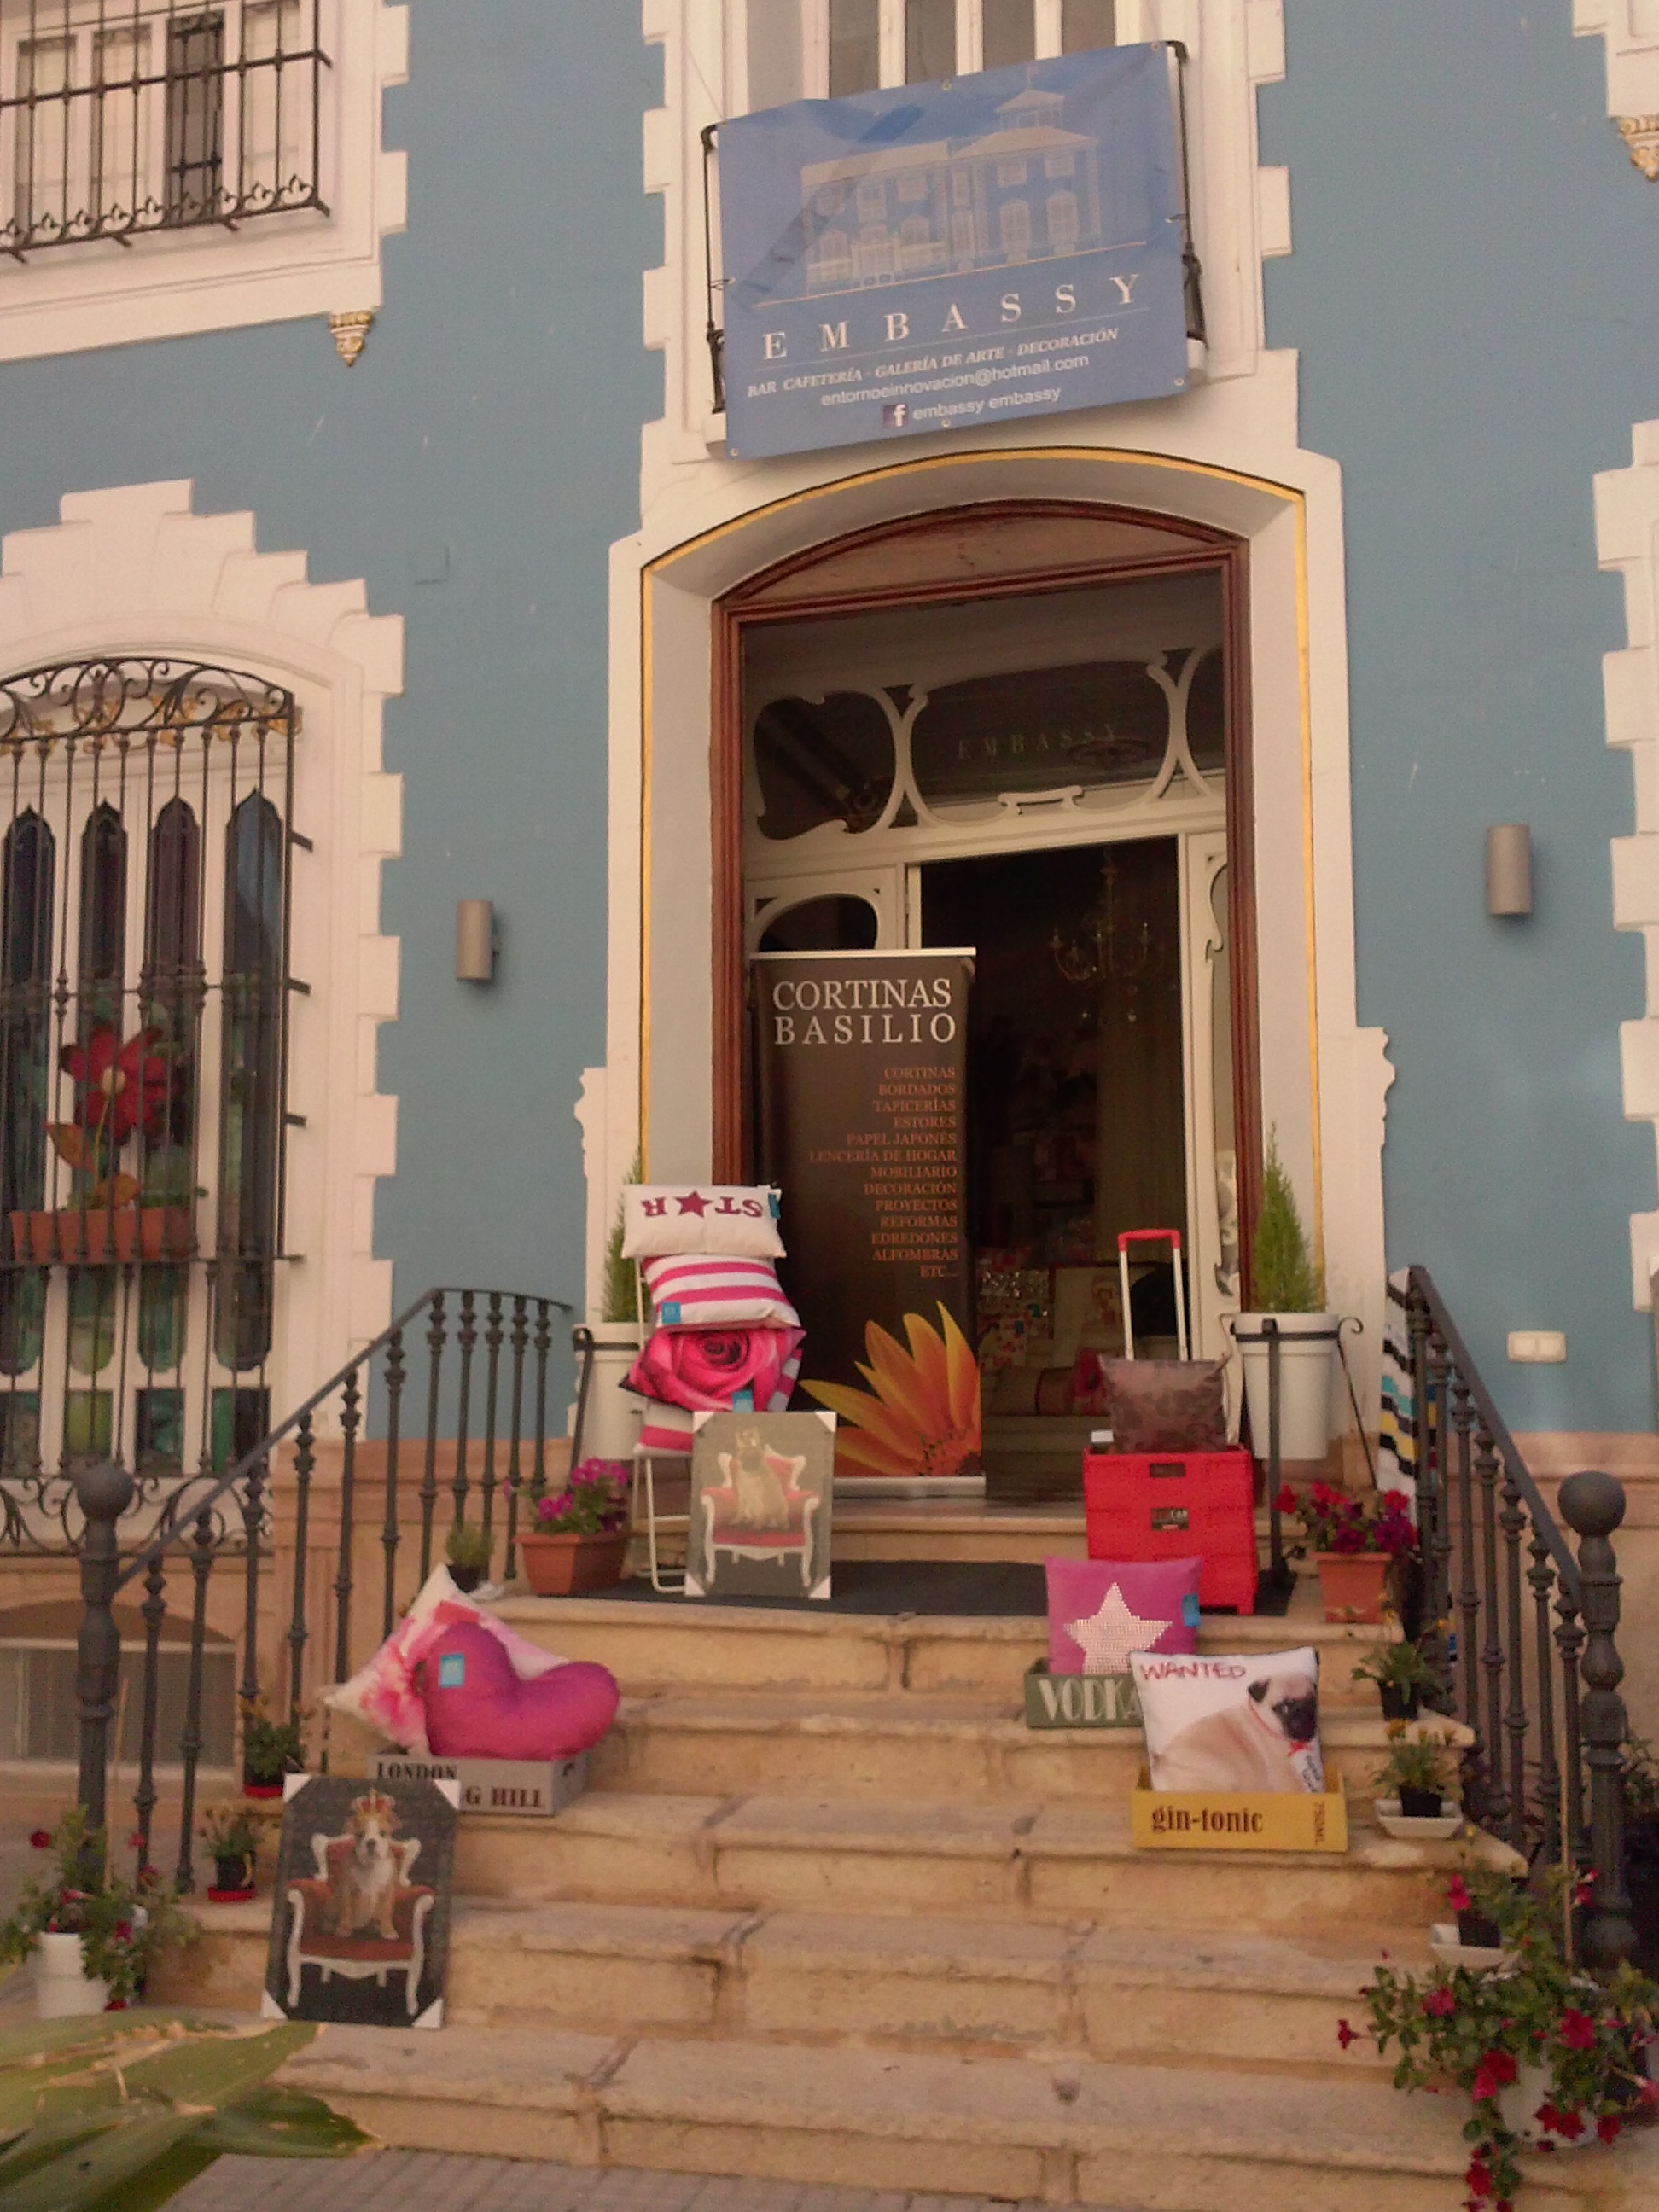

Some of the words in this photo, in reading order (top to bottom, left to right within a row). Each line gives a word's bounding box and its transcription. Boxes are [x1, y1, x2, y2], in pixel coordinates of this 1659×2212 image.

[762, 273, 1139, 360] EMBASSY
[748, 381, 777, 398] BAR
[783, 367, 863, 392] CAFETERÍA
[875, 354, 937, 378] GALERÍA
[941, 354, 963, 368] DE
[965, 347, 1004, 364] ARTE
[1017, 328, 1119, 356] DECORACIÓN
[912, 399, 984, 420] embassy
[988, 387, 1062, 409] embassy
[772, 978, 952, 1010] CORTINAS
[774, 1013, 957, 1045] BASILIO
[884, 1066, 956, 1080] CORTINAS
[878, 1083, 956, 1096] BORDADOS
[894, 1116, 957, 1128] ESTORES
[847, 1133, 890, 1146] PAPEL
[882, 1150, 902, 1162] DE
[906, 1150, 957, 1162] HOGAR
[870, 1166, 958, 1179] MOBILIARIO
[875, 1199, 958, 1212] PROYECTOS
[880, 1215, 958, 1228] REFORMAS
[871, 1232, 958, 1245] EDREDONES
[872, 1249, 959, 1262] ALFOMBRAS
[1139, 1662, 1246, 1681] WANTED
[376, 1762, 457, 1780] LONDON
[491, 1785, 544, 1808] HILL
[1151, 1806, 1264, 1834] gin-tonic
